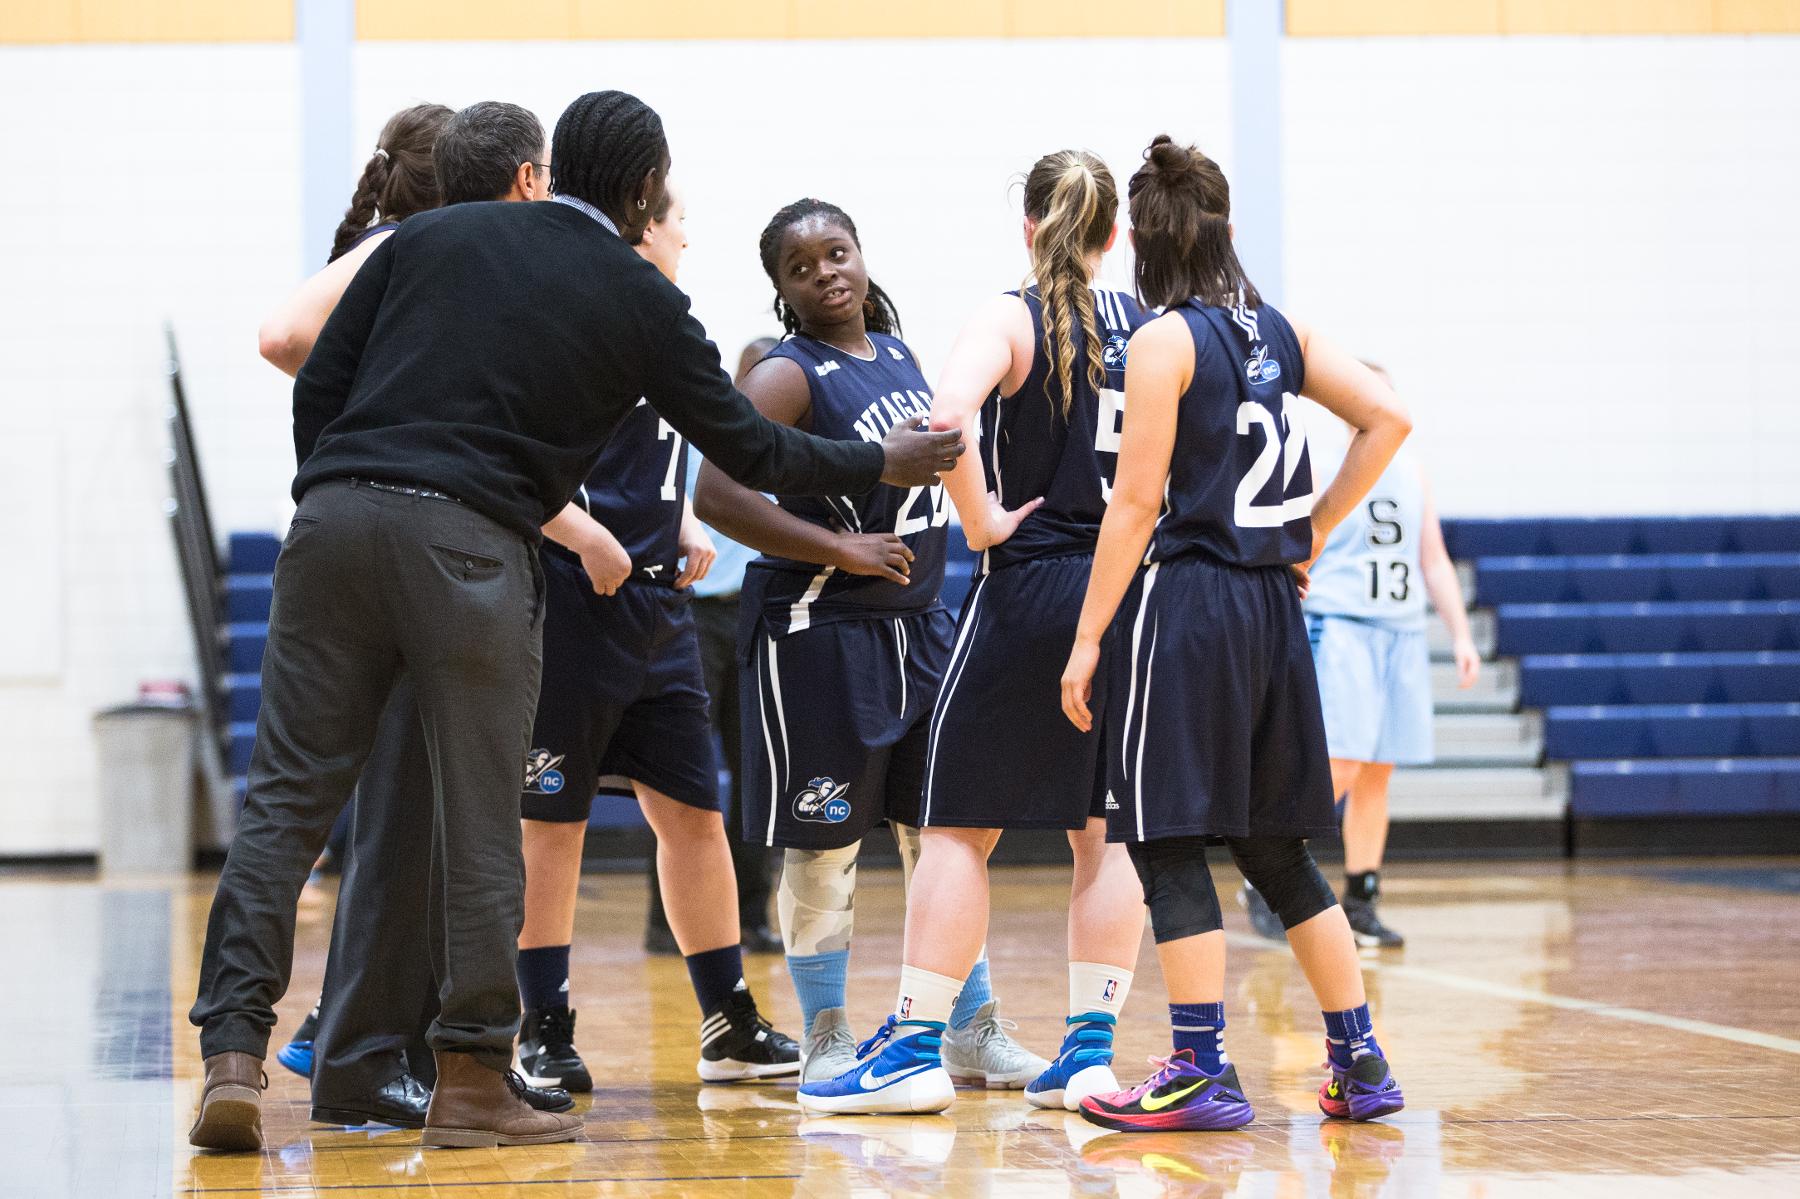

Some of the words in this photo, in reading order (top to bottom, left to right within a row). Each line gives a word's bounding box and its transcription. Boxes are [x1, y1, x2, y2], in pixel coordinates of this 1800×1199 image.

[657, 417, 682, 501] 7
[1234, 391, 1313, 527] 22
[1367, 499, 1403, 546] S
[1367, 561, 1409, 601] 13
[543, 774, 560, 787] nc
[830, 805, 846, 816] nc
